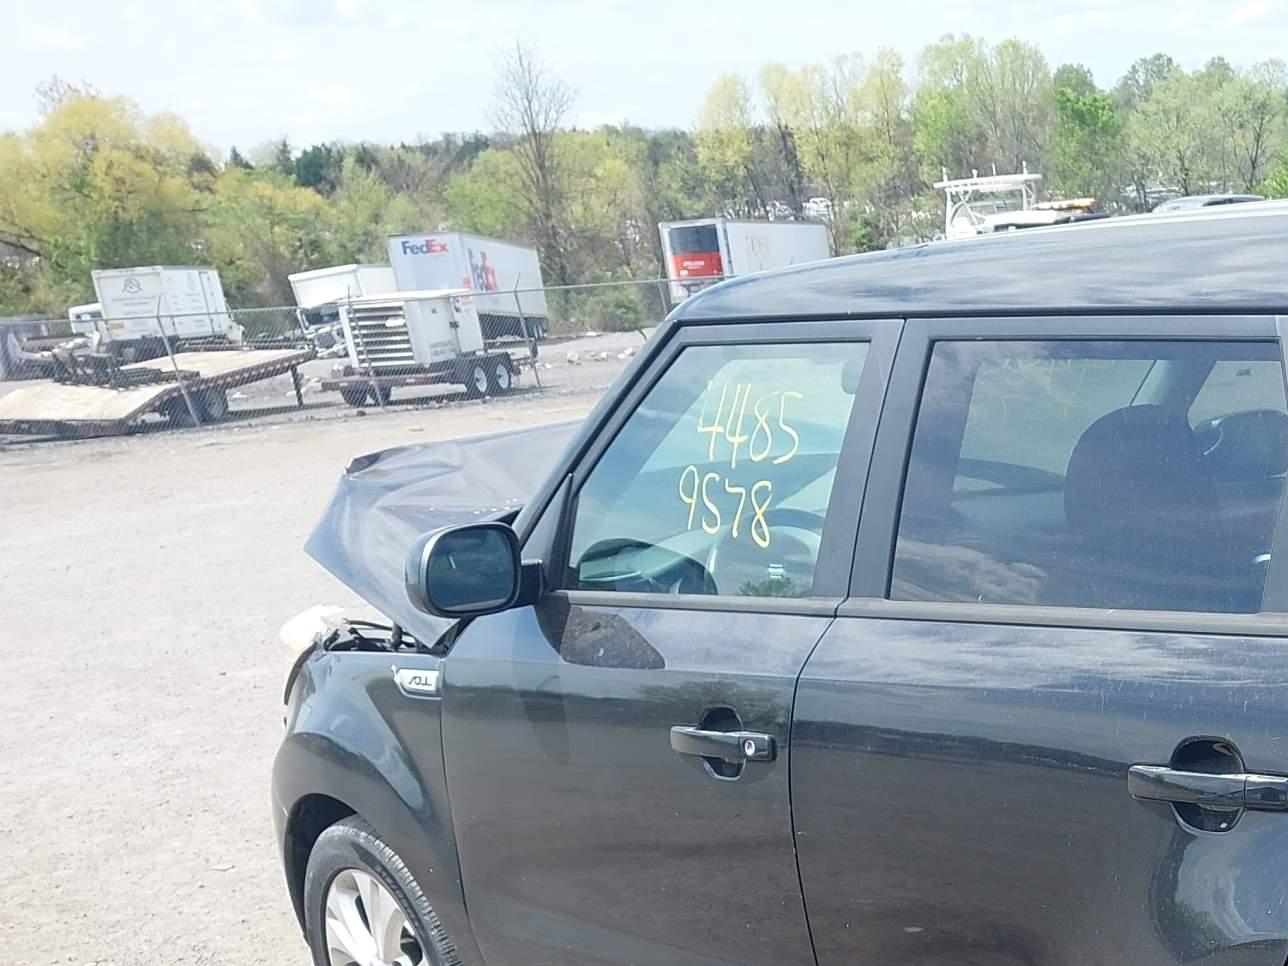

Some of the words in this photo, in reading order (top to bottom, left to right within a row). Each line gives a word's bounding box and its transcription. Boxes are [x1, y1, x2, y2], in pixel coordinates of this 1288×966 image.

[401, 240, 448, 255] FedEx
[697, 380, 803, 469] 4485
[679, 465, 773, 548] 9578
